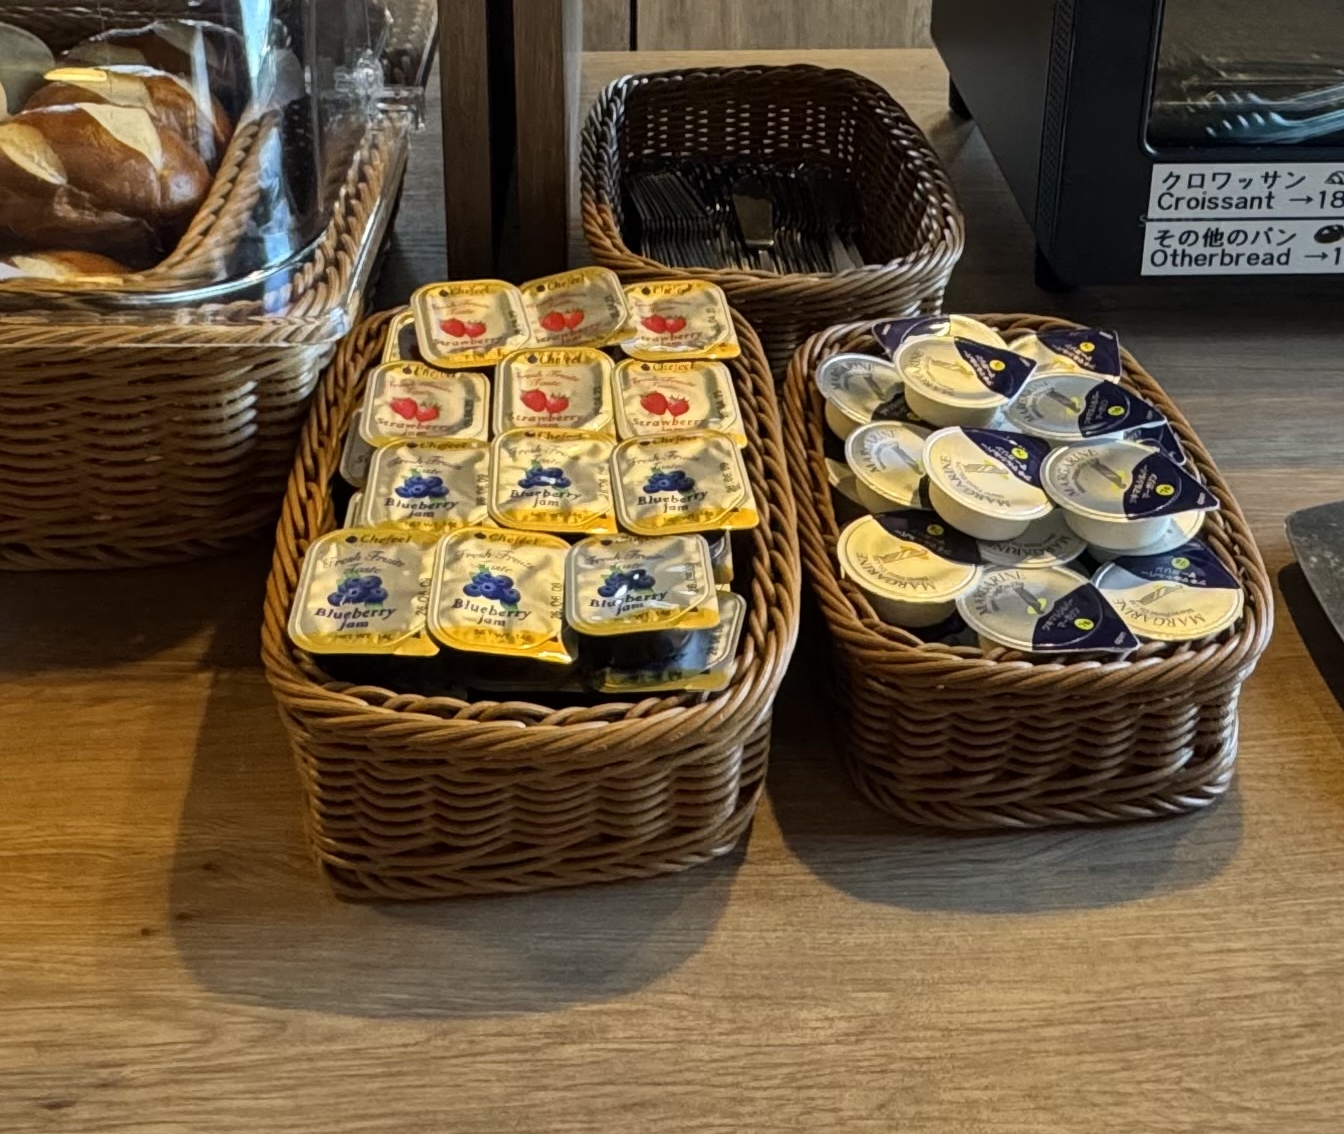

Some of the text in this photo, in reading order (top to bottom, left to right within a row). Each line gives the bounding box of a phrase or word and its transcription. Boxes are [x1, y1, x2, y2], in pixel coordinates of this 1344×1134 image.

[1161, 170, 1306, 191] クロワッサン
[1157, 191, 1275, 210] Croissant
[1153, 227, 1297, 248] その他のパン
[1150, 247, 1291, 267] Otherbread
[940, 454, 1012, 509] MARGARINE
[1057, 449, 1098, 497] MARGARINE
[384, 497, 459, 510] Blueberry
[510, 489, 581, 500] Blueberry
[637, 490, 709, 506] Blueberry
[856, 551, 937, 592] MARGARINE
[589, 591, 668, 608] Bluberry
[974, 570, 1027, 616] MARGARINE
[314, 607, 398, 620] Blueberry
[451, 598, 531, 621] Blueberry
[1113, 597, 1206, 627] MARGARINE
